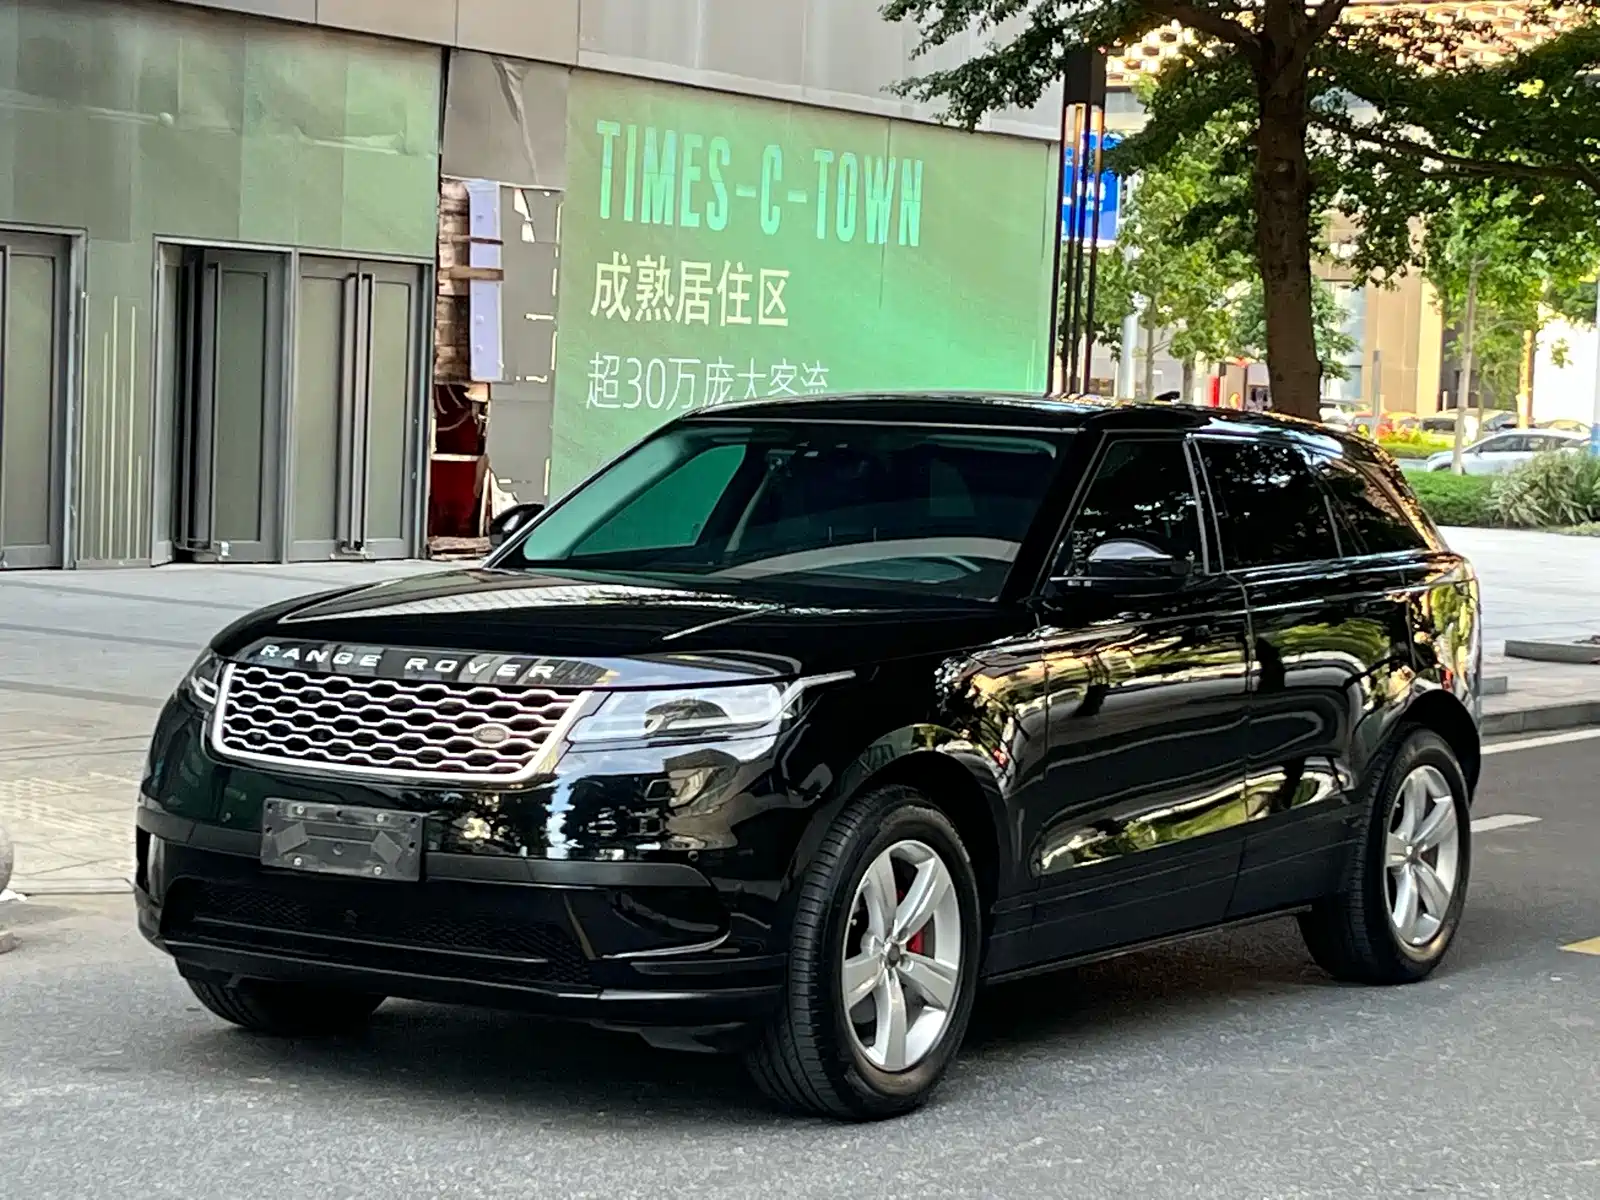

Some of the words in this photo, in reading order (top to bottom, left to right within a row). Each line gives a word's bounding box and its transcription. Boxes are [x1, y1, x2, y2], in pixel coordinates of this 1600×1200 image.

[596, 119, 924, 247] TIMES-C-TOWN
[590, 250, 791, 327] 成熟居住区
[260, 644, 382, 667] RANGE
[404, 657, 555, 679] ROVER
